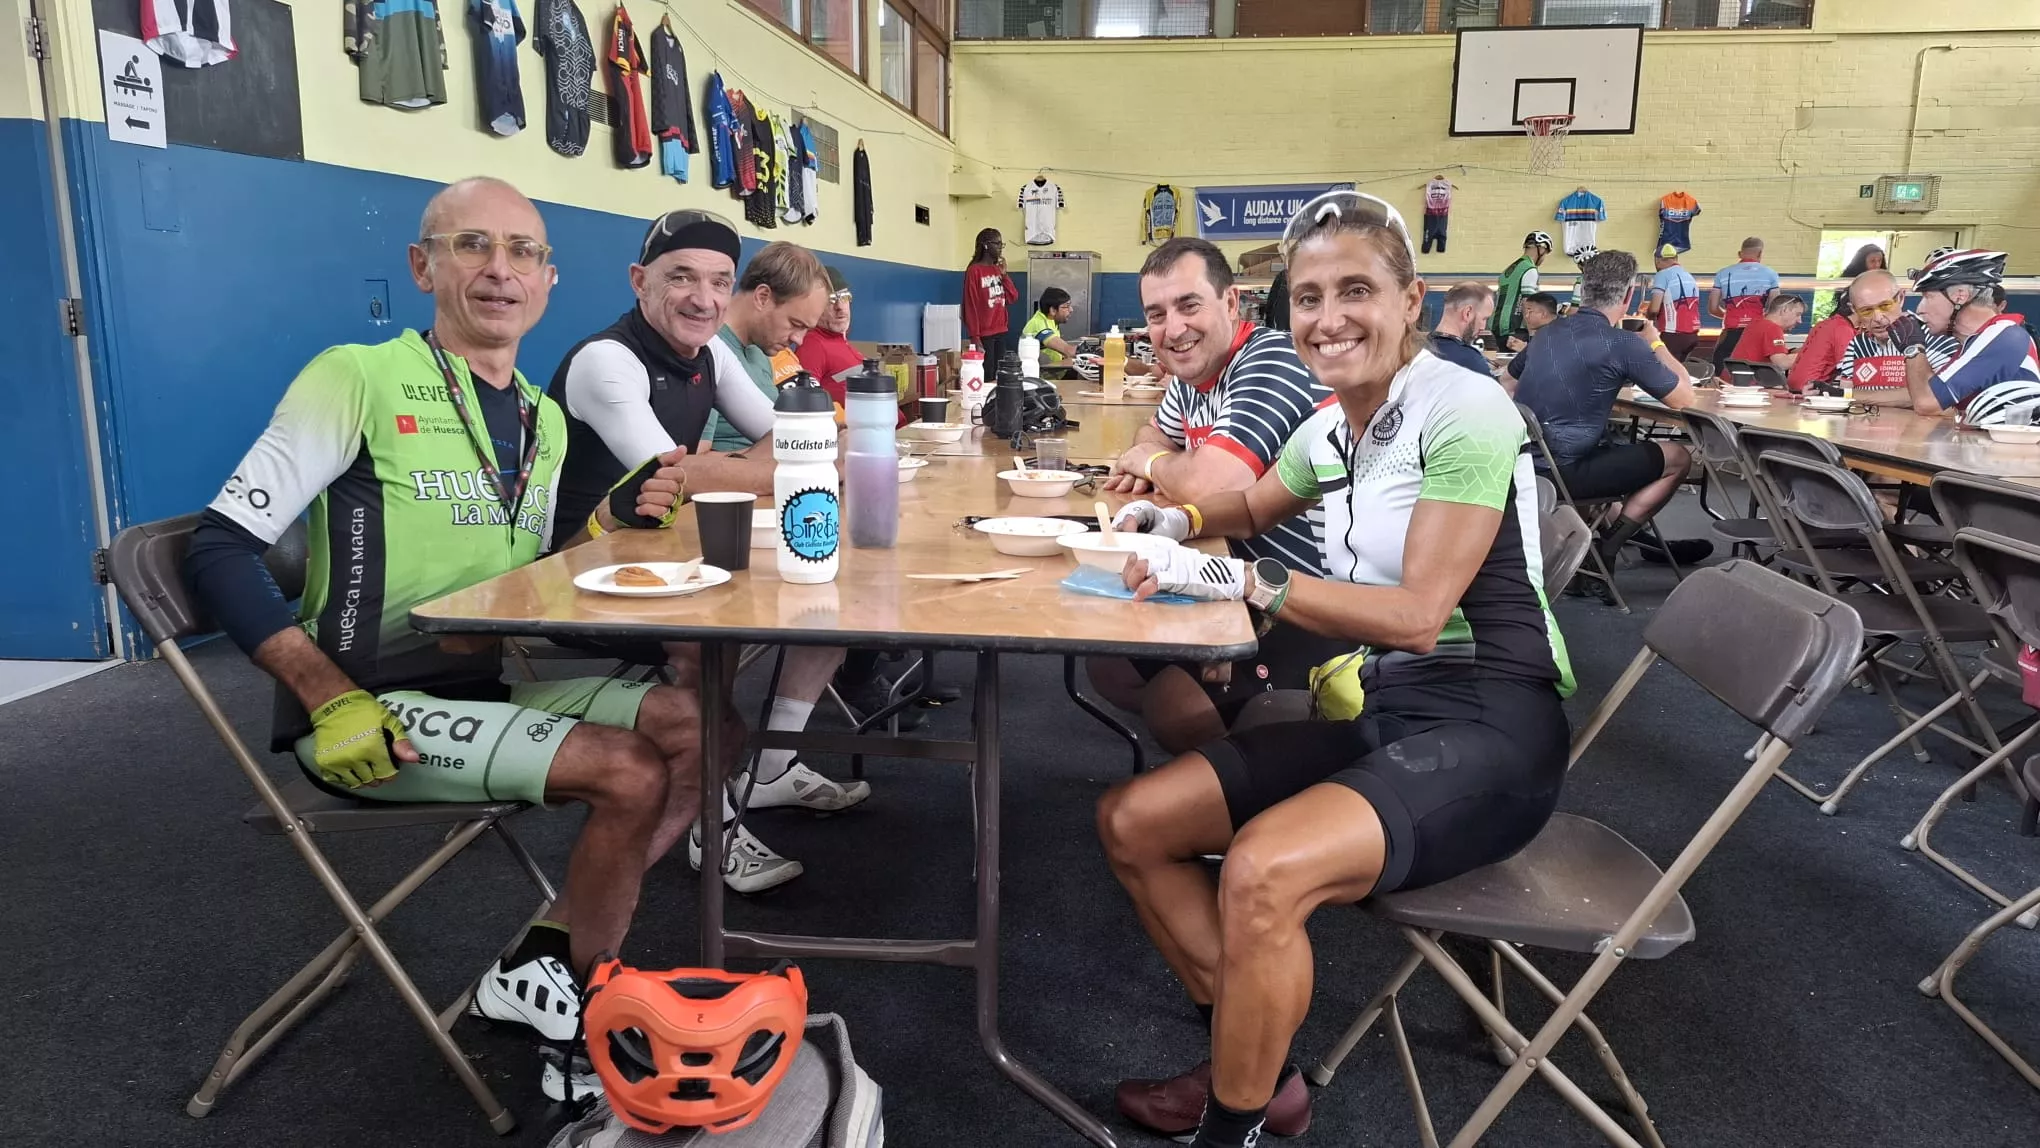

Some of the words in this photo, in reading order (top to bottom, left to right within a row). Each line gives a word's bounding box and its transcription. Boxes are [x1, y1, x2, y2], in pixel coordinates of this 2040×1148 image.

[1244, 199, 1284, 217] AUDAX
[1243, 216, 1257, 226] long
[1257, 216, 1282, 225] distance
[420, 426, 431, 434] de
[433, 426, 465, 435] Huesca
[791, 439, 823, 450] Ciclista
[419, 752, 465, 770] ense
